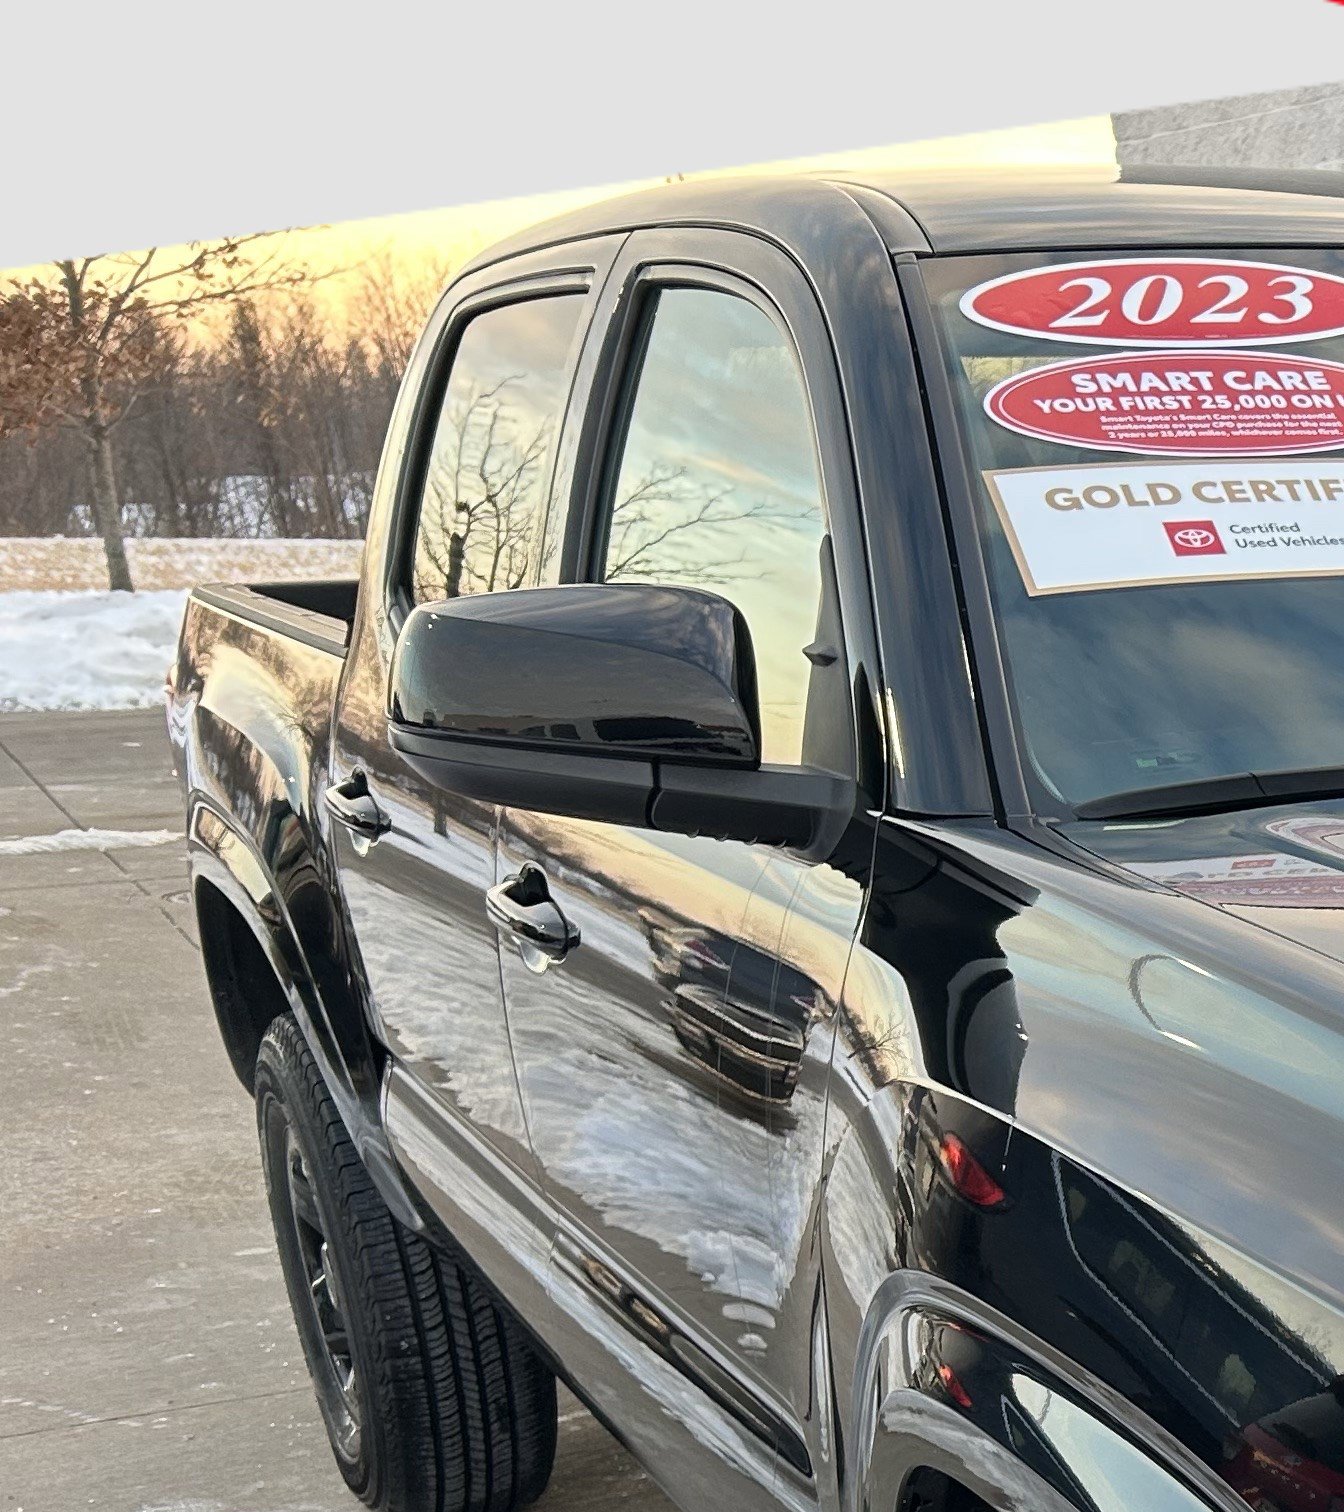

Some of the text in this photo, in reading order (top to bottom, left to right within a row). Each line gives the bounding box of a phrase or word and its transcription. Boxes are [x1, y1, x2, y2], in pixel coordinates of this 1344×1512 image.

[1047, 273, 1315, 329] 2023
[1071, 370, 1332, 393] SMART CARE
[1033, 397, 1117, 414] YOUR
[1119, 395, 1192, 411] FIRST
[1200, 395, 1284, 412] 25,000
[1291, 394, 1333, 409] ON
[1044, 482, 1183, 511] GOLD
[1229, 522, 1301, 535] Certified
[1234, 537, 1278, 549] Used
